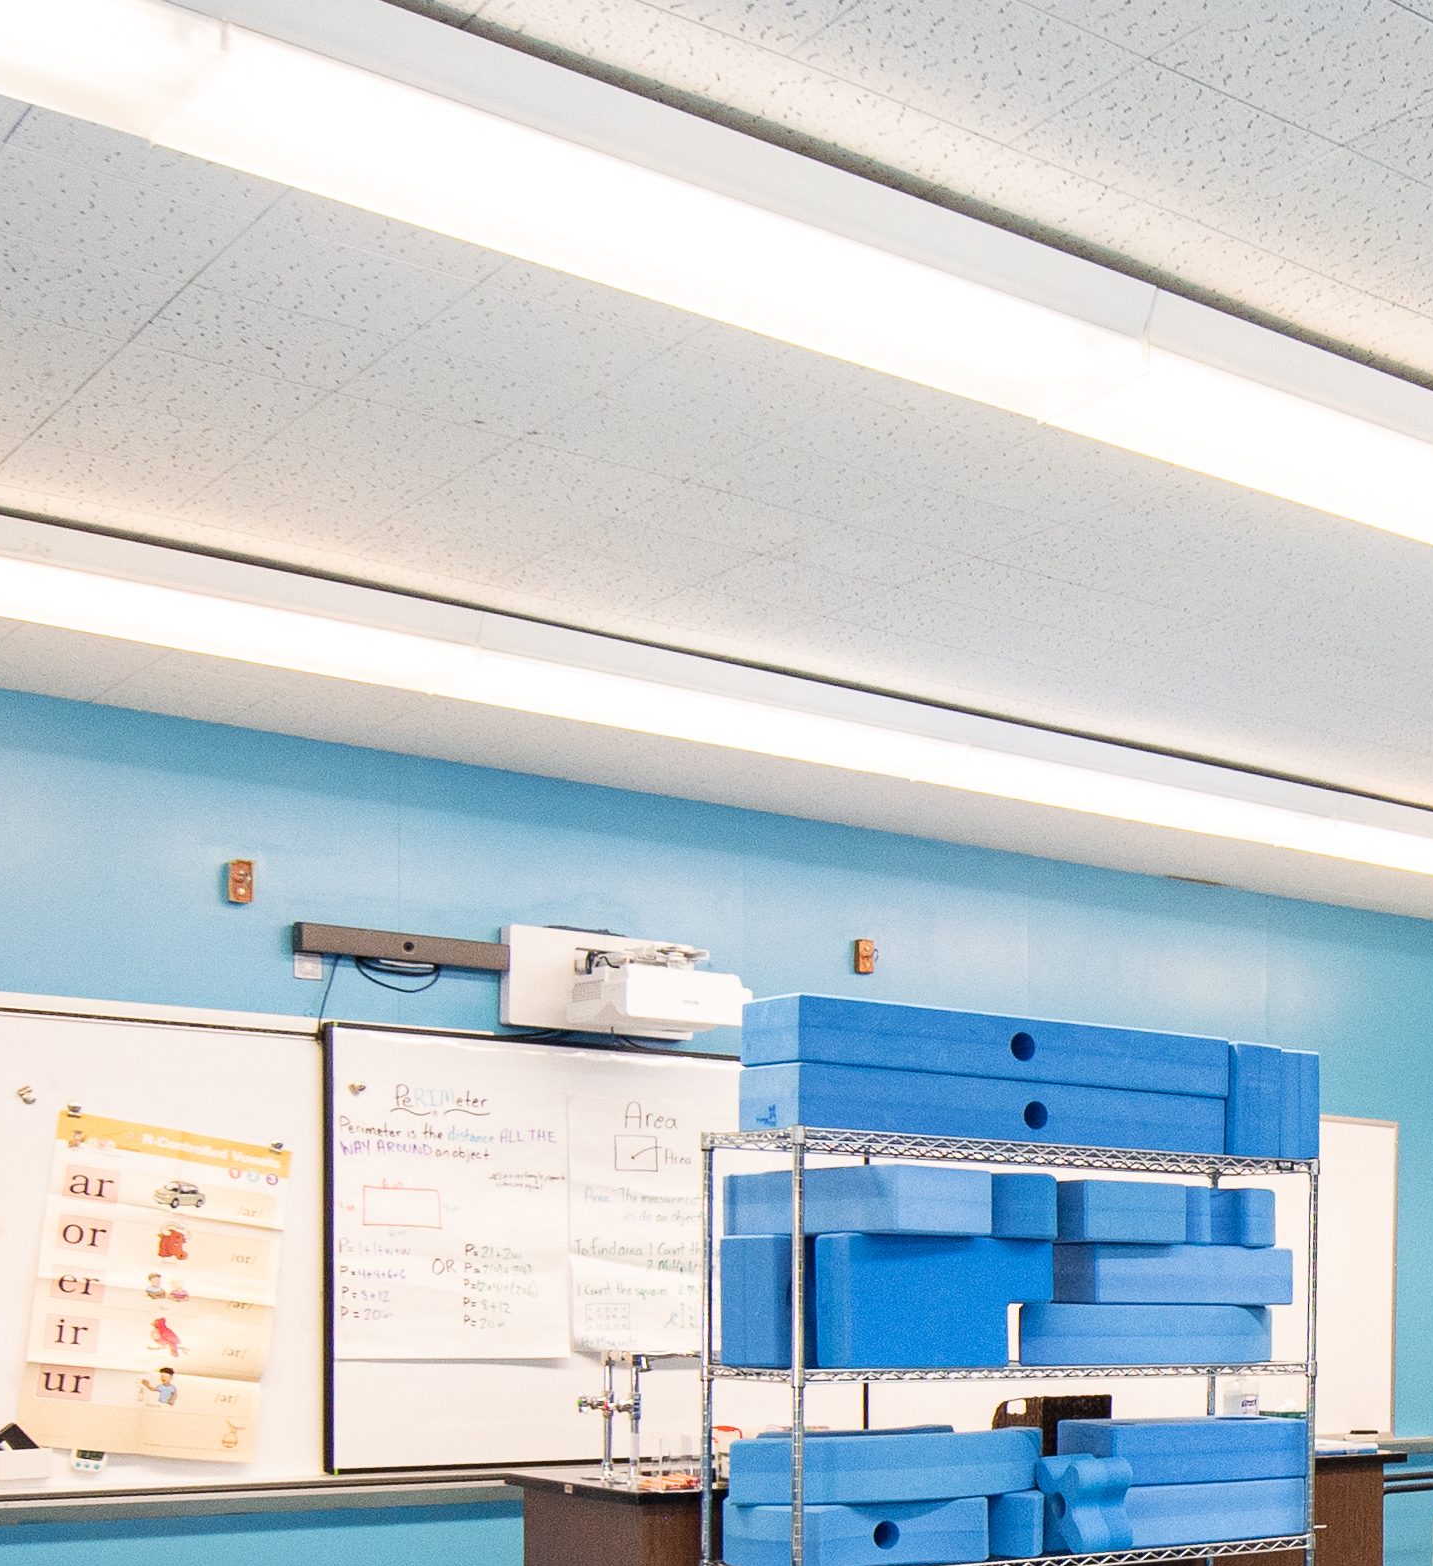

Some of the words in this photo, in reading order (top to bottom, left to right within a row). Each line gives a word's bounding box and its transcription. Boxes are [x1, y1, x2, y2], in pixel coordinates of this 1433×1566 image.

[624, 1101, 678, 1129] Area
[339, 1116, 402, 1138] Perimeter
[407, 1128, 417, 1139] is
[422, 1122, 443, 1140] the
[448, 1125, 495, 1144] distance
[500, 1129, 524, 1143] ALL
[531, 1129, 558, 1143] THE
[141, 1134, 227, 1159] R-Controlled
[232, 1149, 281, 1168] Vowels
[340, 1139, 370, 1155] WAY
[377, 1139, 433, 1156] AROUND
[435, 1148, 451, 1157] an
[665, 1148, 692, 1164] Area
[69, 1173, 114, 1198] ar
[238, 1207, 264, 1219] /ar/
[619, 1188, 638, 1202] The
[62, 1224, 107, 1247] or
[230, 1251, 258, 1265] /or/
[574, 1239, 588, 1255] To
[592, 1237, 616, 1256] find
[618, 1246, 643, 1256] area
[657, 1242, 684, 1256] Count
[432, 1258, 457, 1275] OR
[58, 1273, 100, 1296] er
[584, 1281, 610, 1296] Count
[54, 1319, 88, 1345] ir
[43, 1371, 91, 1394] ur
